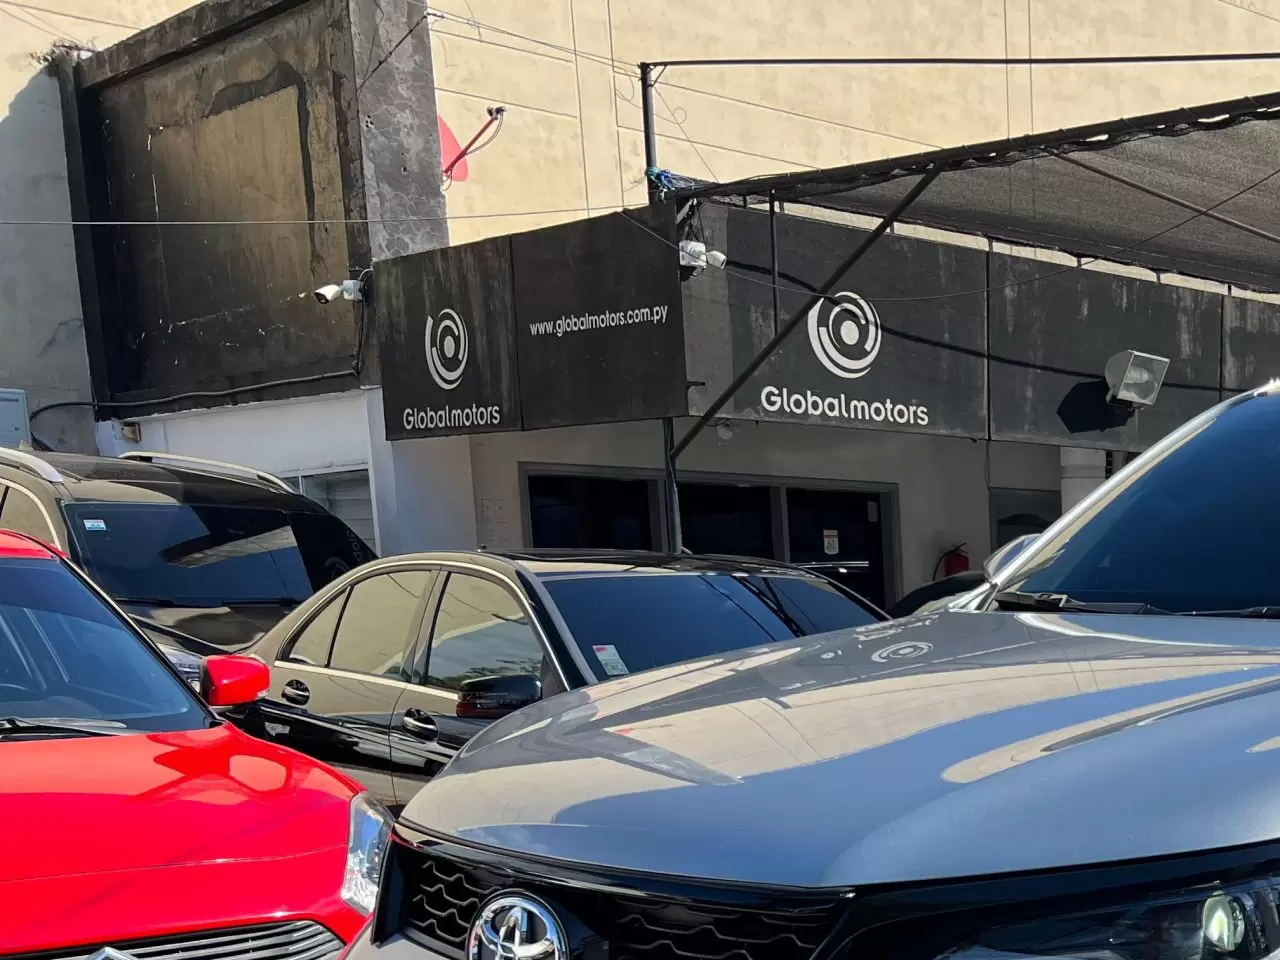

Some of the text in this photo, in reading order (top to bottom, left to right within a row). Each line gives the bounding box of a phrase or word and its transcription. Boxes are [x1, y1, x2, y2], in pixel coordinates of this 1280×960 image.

[529, 304, 668, 337] www.globalmotors.com.py
[403, 403, 501, 430] Globalmotors
[760, 385, 930, 426] Globalmotors
